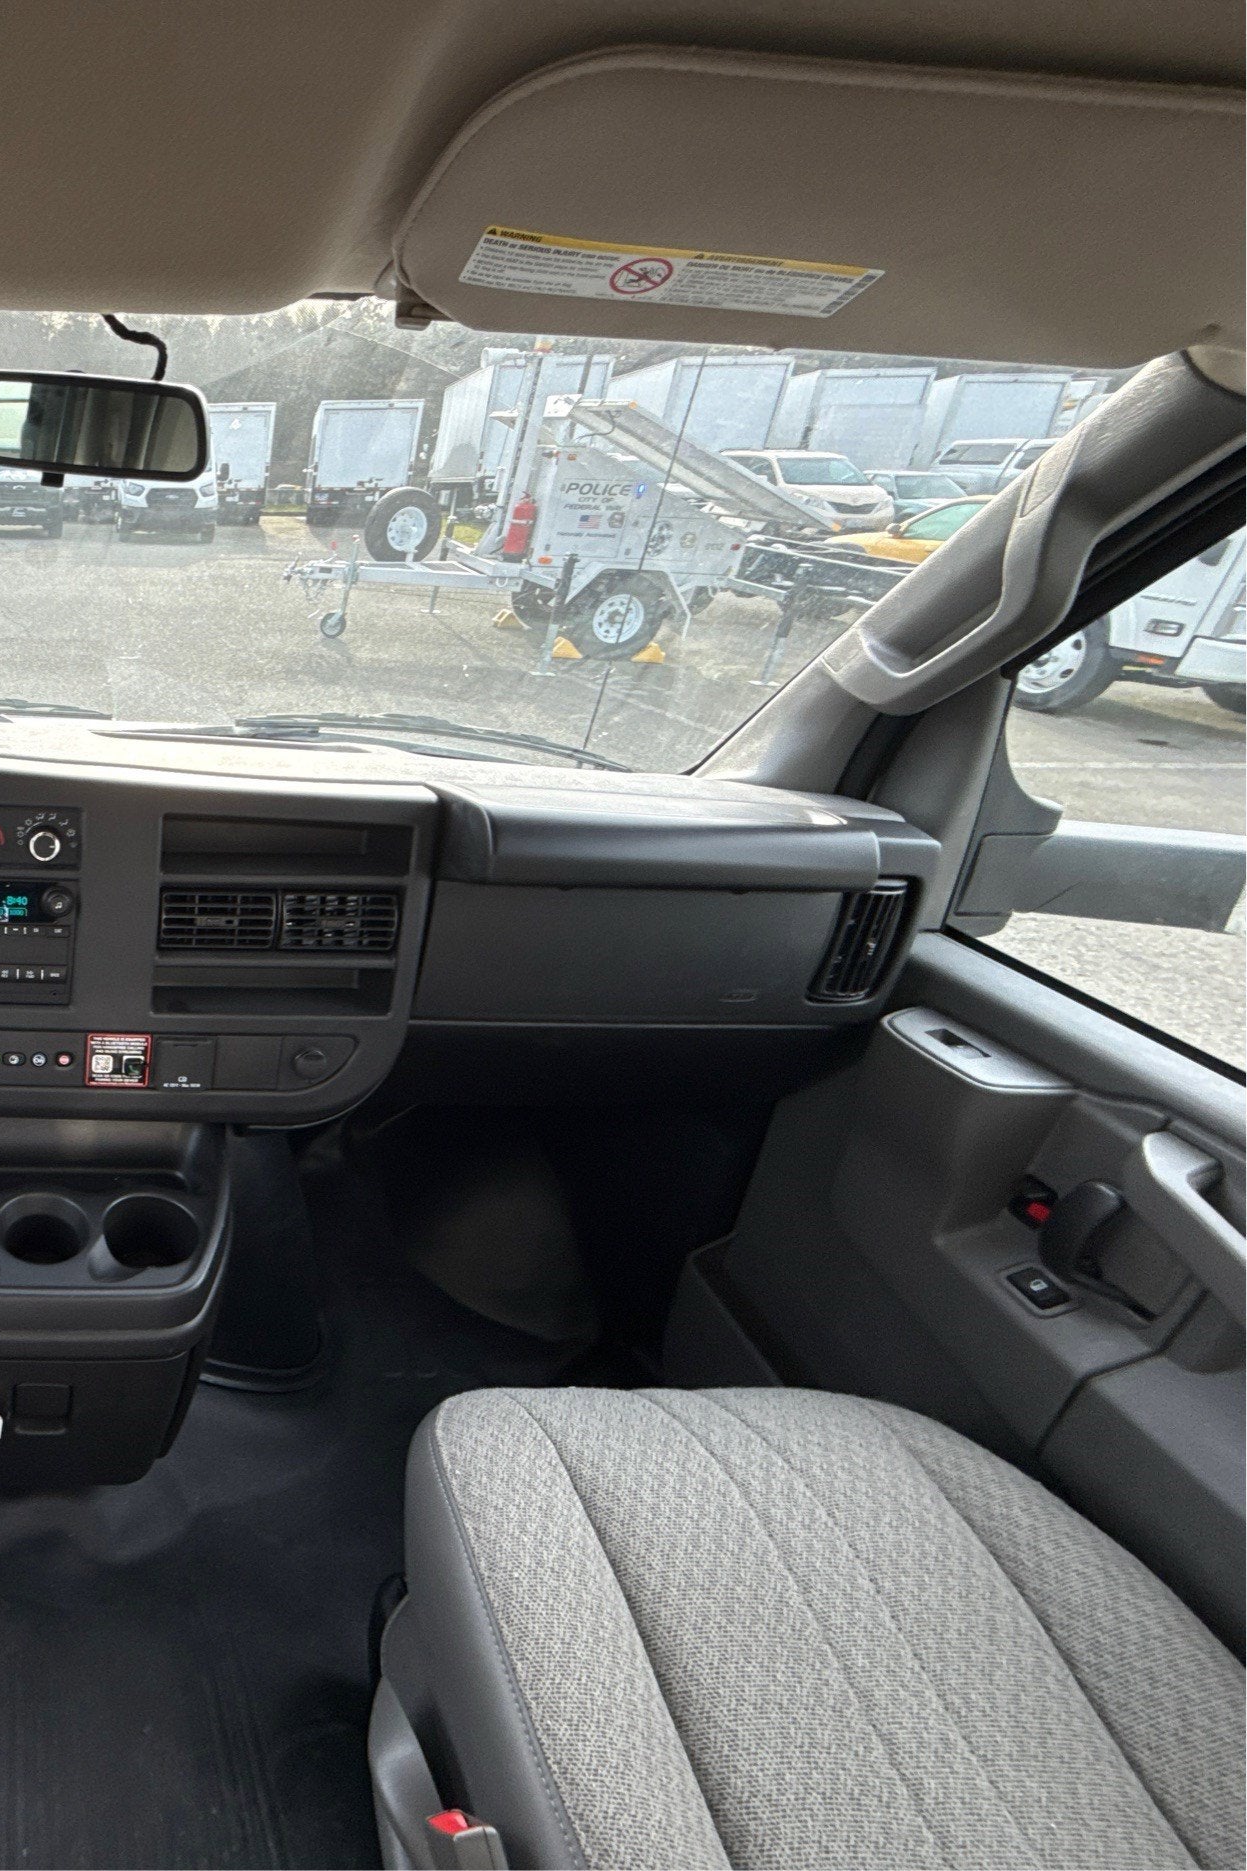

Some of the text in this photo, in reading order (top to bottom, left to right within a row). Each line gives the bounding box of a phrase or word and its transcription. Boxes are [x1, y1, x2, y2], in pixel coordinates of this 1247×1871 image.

[500, 230, 544, 243] WARNING
[482, 237, 509, 247] DEATH
[519, 243, 552, 254] SERIOUS
[565, 482, 633, 497] POLICE
[563, 503, 601, 511] FEDERAL
[6, 895, 28, 906] 8:40
